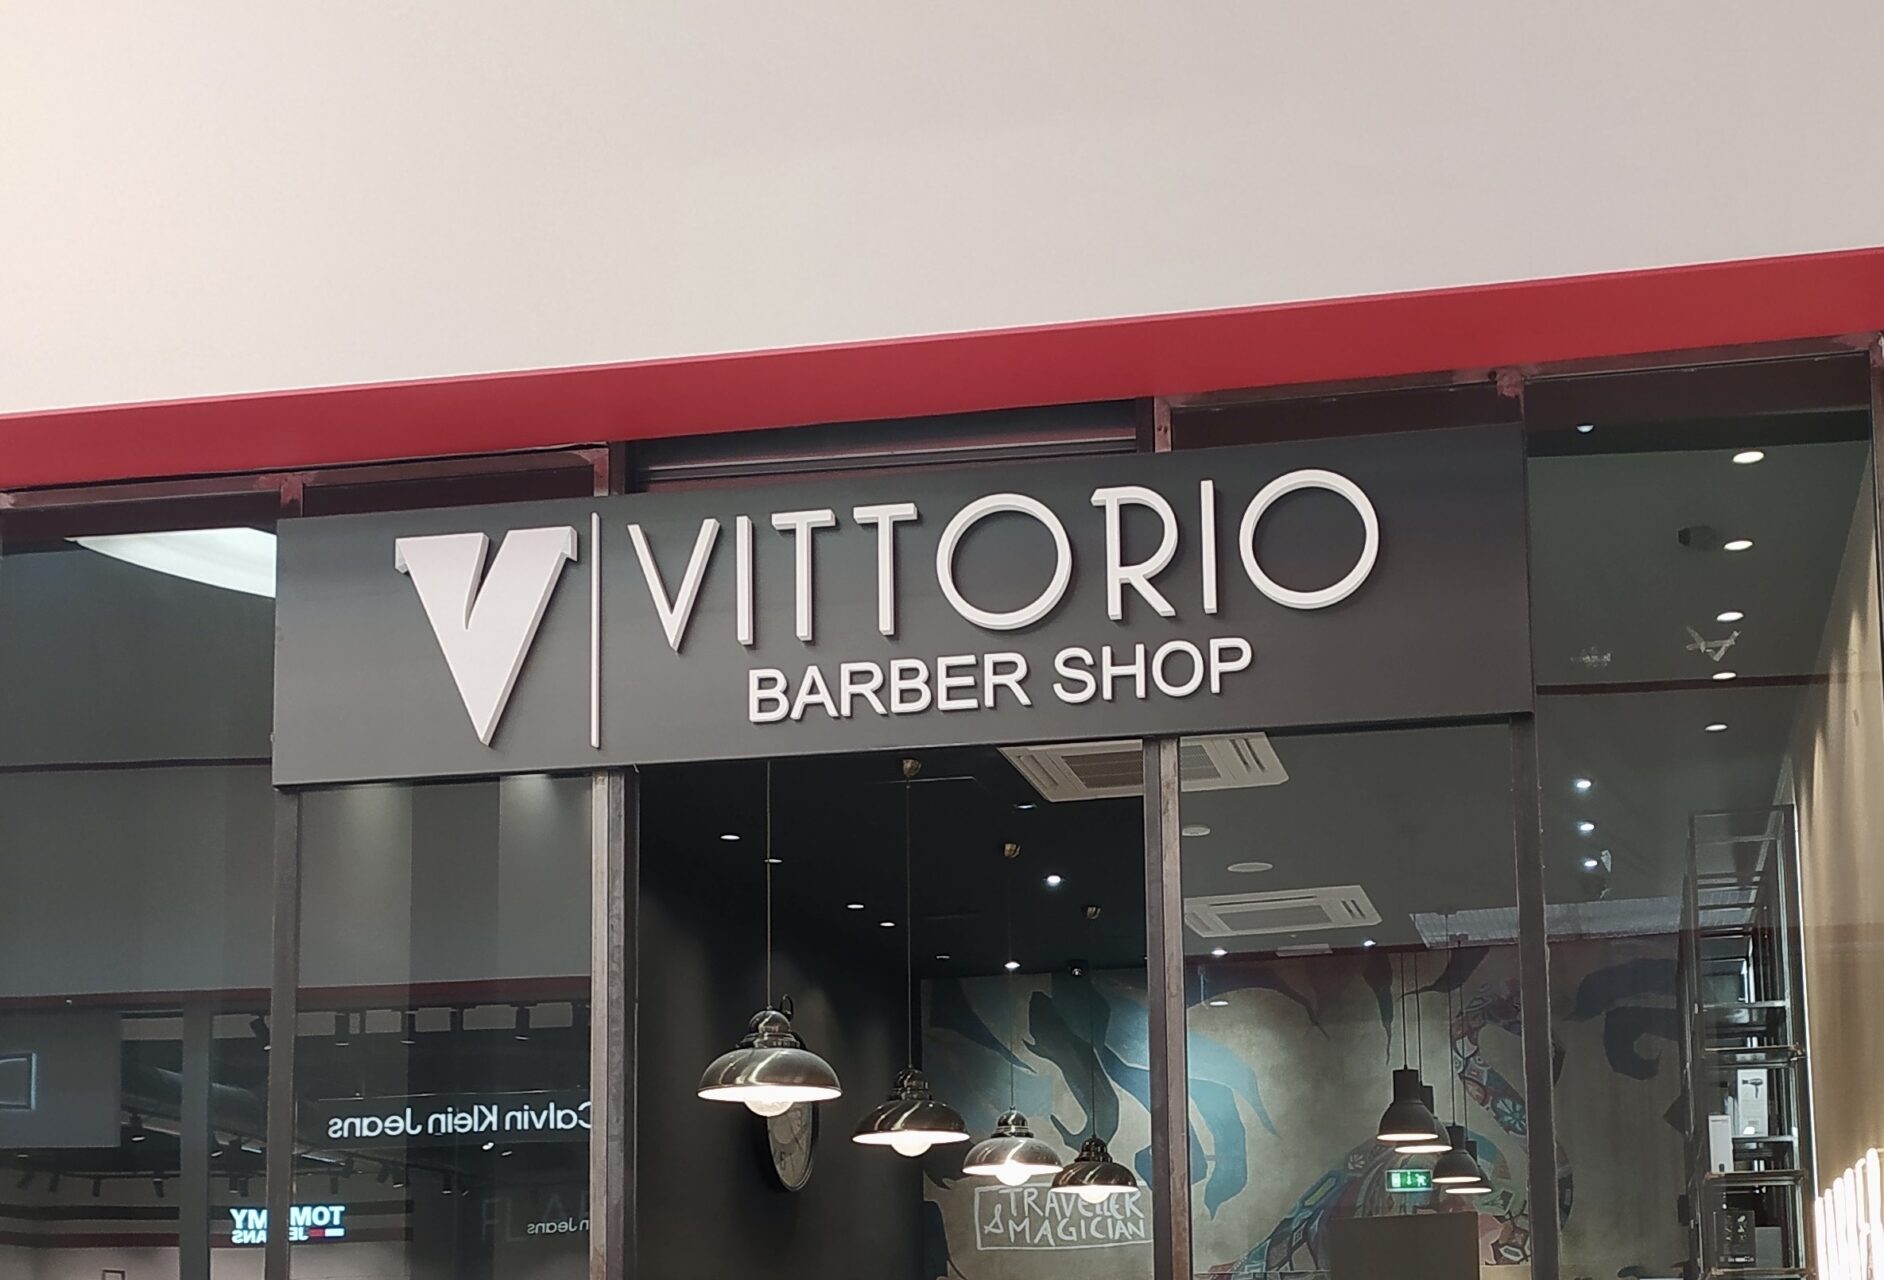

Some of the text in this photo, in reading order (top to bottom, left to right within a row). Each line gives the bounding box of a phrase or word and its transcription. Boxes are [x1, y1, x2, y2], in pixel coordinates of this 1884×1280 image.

[628, 468, 1381, 652] VITTORIO
[746, 634, 1255, 725] BARBER SHOP
[1008, 1217, 1145, 1247] MAGICIAN
